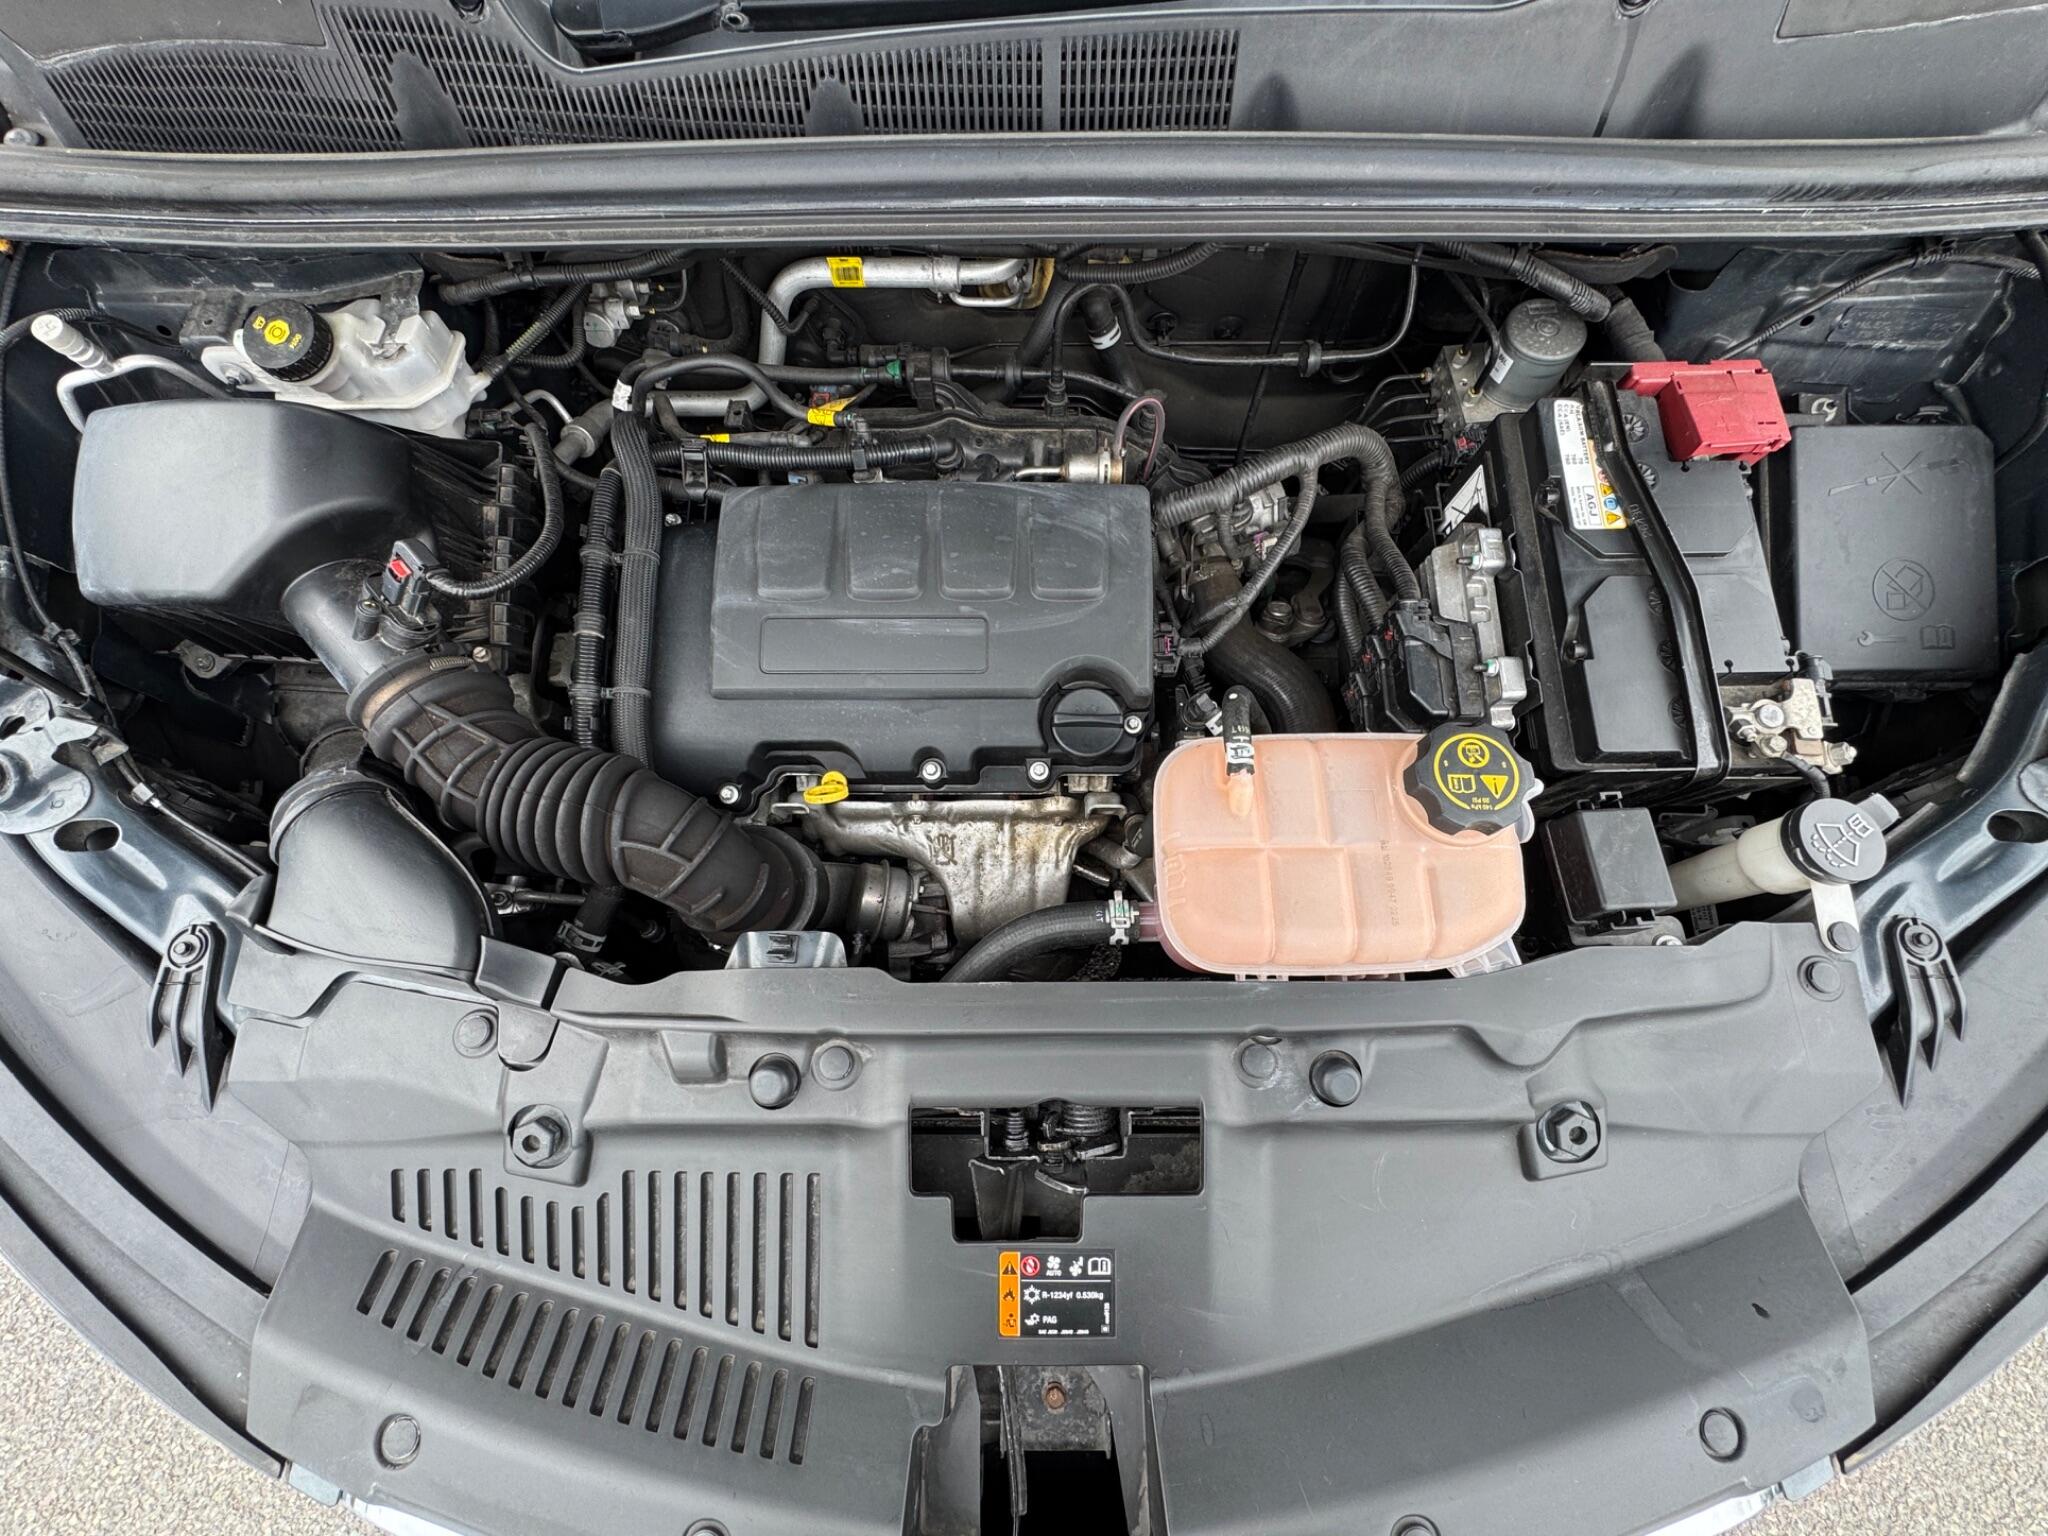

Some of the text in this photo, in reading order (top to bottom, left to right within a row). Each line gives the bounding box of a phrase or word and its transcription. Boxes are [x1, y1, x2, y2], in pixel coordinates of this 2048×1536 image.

[1046, 1269, 1062, 1277] AUTO
[1041, 1291, 1074, 1301] R-1234yf
[1042, 1315, 1058, 1324] PAG
